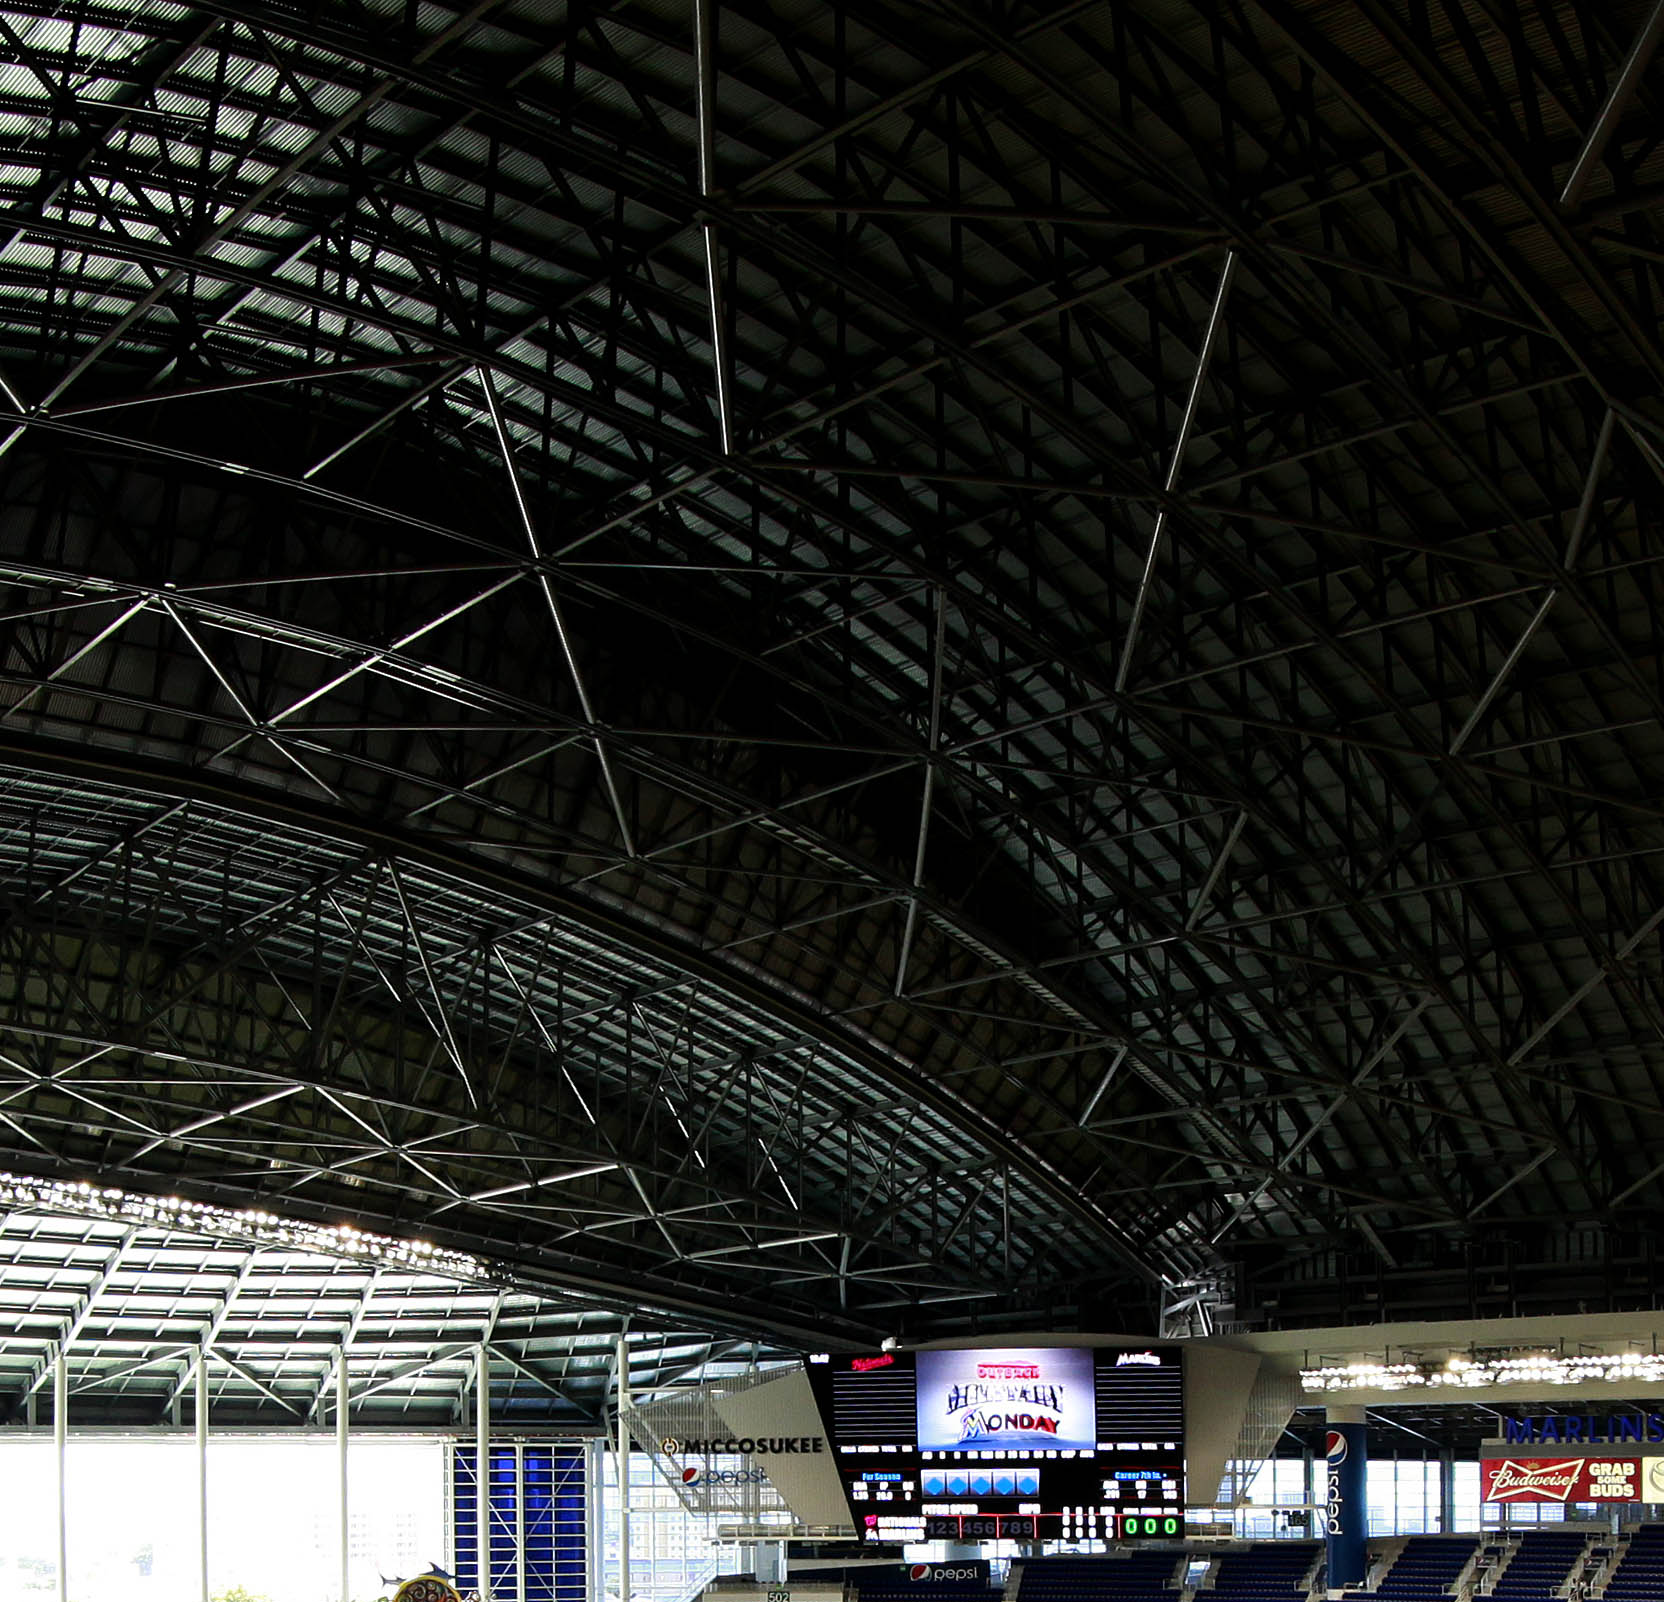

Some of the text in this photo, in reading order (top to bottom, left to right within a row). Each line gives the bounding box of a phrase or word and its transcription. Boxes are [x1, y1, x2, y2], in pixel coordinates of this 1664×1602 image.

[977, 1365, 1040, 1379] OUTBACK
[959, 1408, 1060, 1443] MONDAY
[1505, 1414, 1664, 1444] MARLINS
[686, 1437, 823, 1454] MICCOSUKEE
[705, 1467, 767, 1487] pepsi
[1588, 1462, 1635, 1477] GRAB
[1489, 1468, 1579, 1489] Budweiser
[1597, 1476, 1627, 1486] SOME
[1589, 1485, 1635, 1498] BUDS
[1327, 1469, 1343, 1535] pepsi
[933, 1567, 978, 1583] pepsi
[768, 1592, 790, 1602] 502
